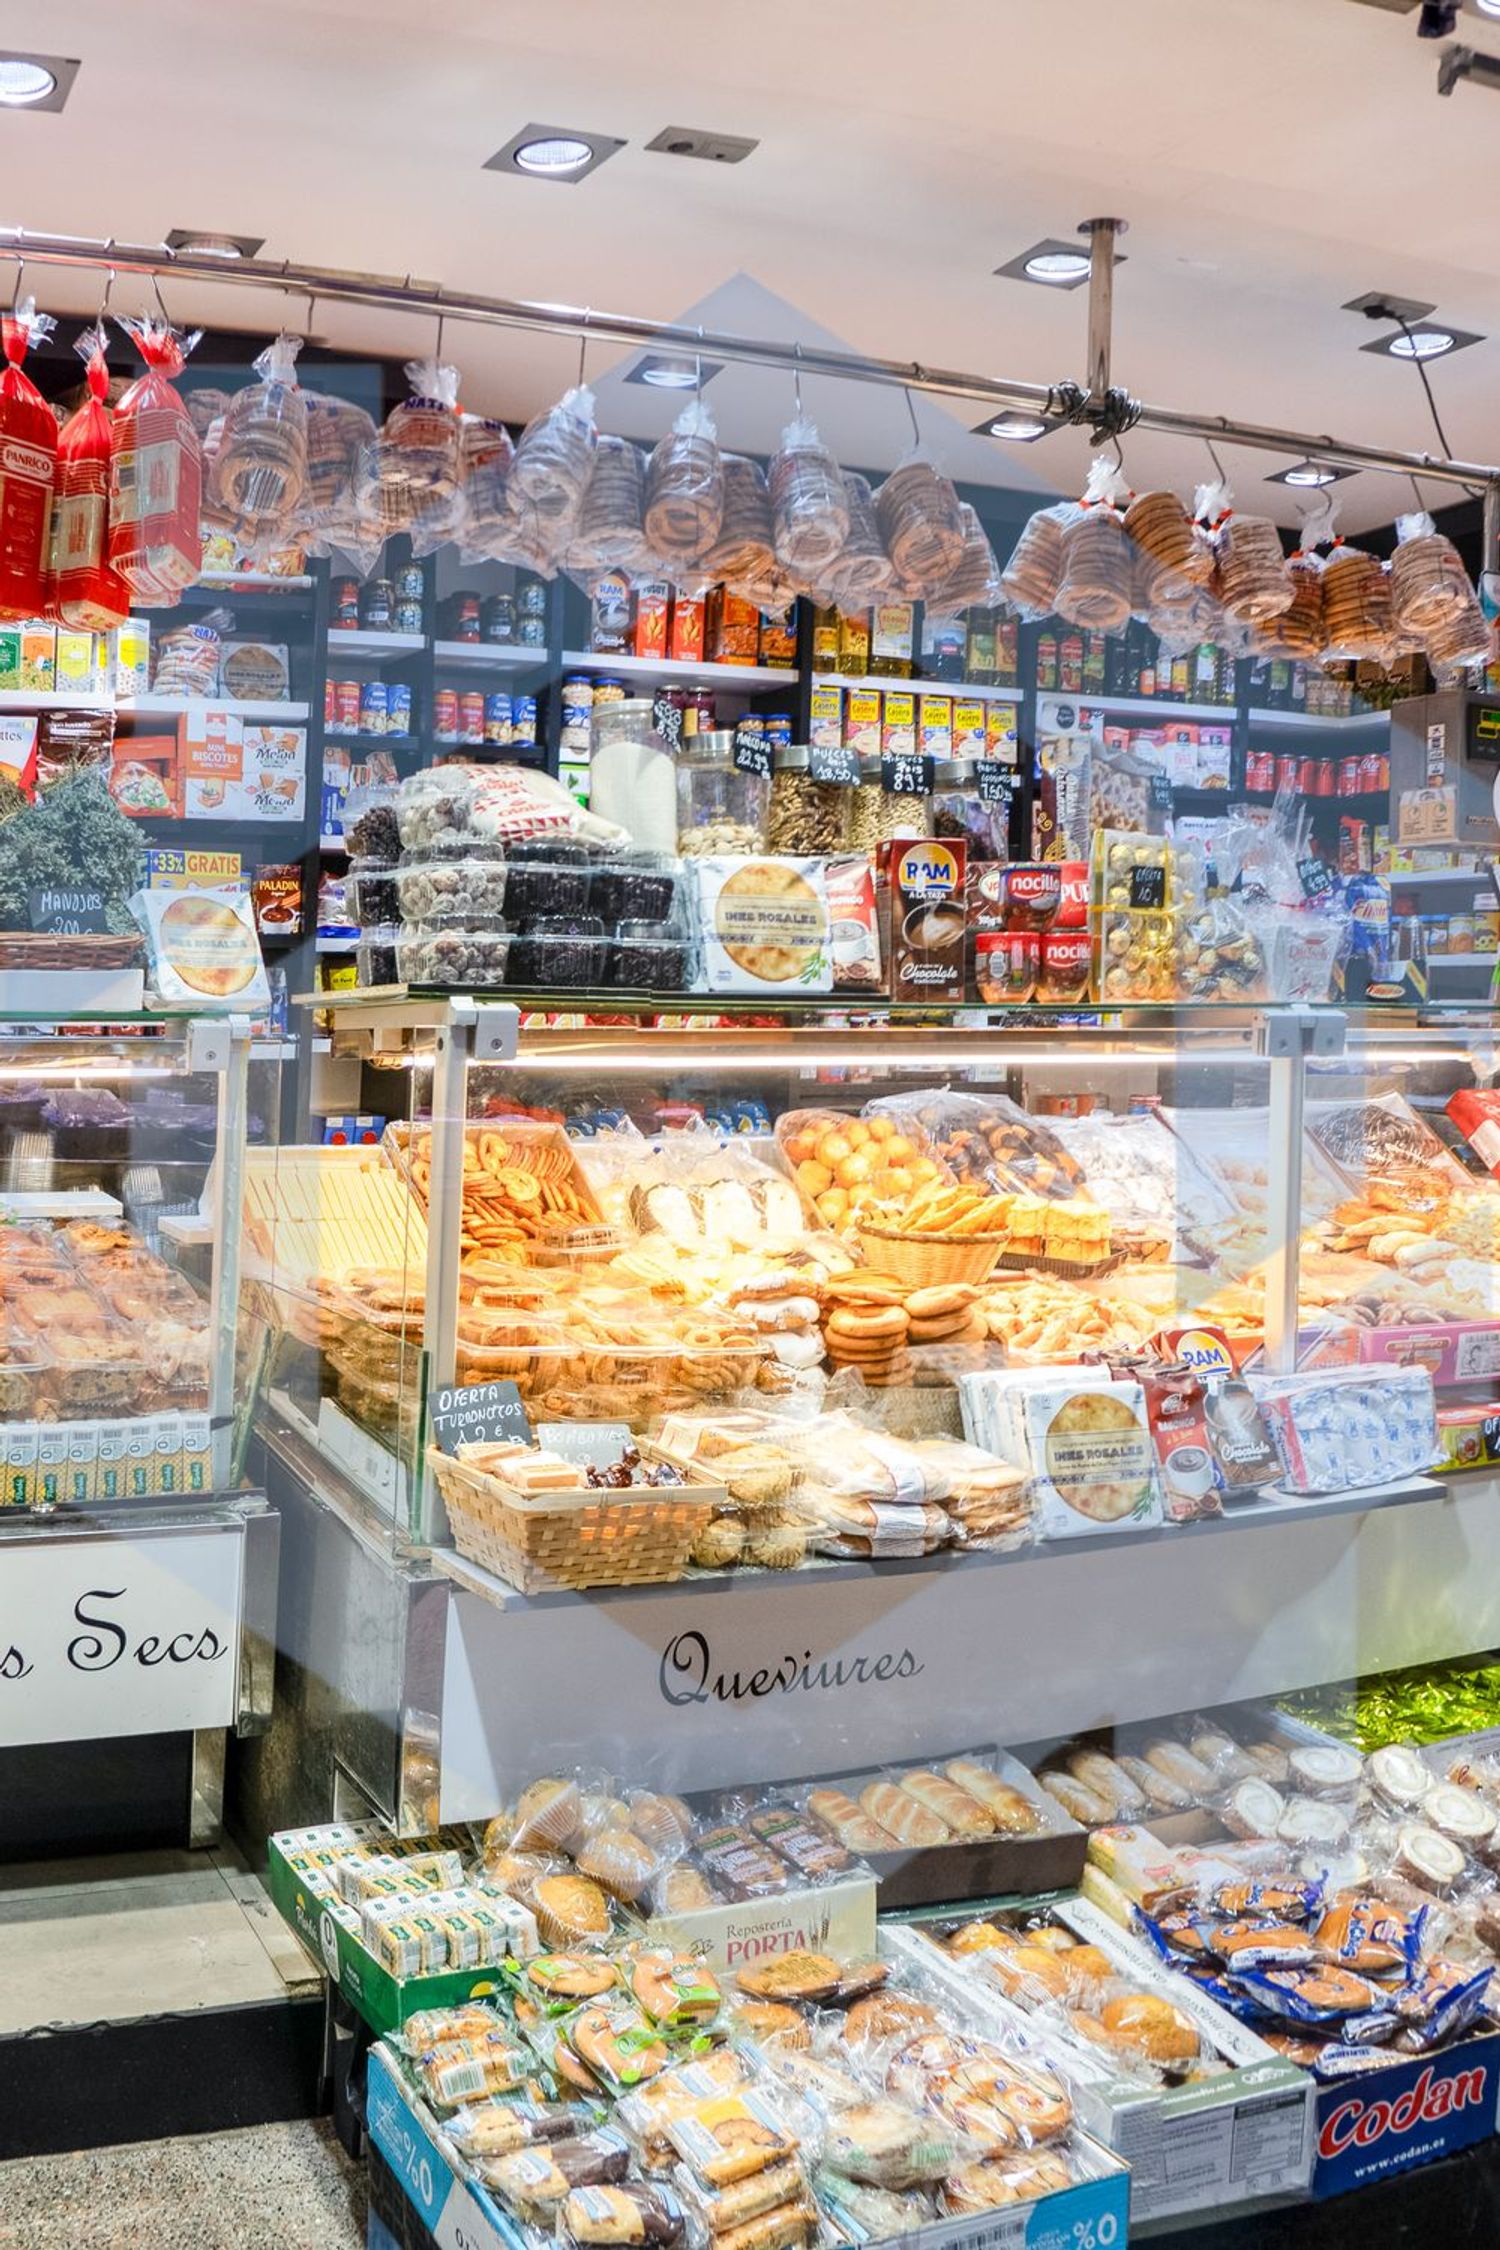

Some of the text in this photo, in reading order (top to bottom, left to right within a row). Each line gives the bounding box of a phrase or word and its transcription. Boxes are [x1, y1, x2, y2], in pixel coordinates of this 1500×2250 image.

[6, 450, 50, 473] PANRICO
[191, 751, 239, 764] BISCOTES
[187, 854, 240, 875] GRATIS
[906, 863, 951, 881] RAM
[259, 880, 299, 892] PALADIN
[41, 891, 103, 913] MANOJOS
[757, 912, 817, 925] ROSALES
[900, 962, 958, 981] Chocolate
[1183, 1347, 1225, 1366] RAM
[439, 1385, 499, 1412] OFERTA
[67, 1587, 229, 1672] Secs
[659, 1630, 926, 1707] Queviures
[726, 1929, 807, 1966] PORTA
[1319, 2065, 1488, 2160] Codan
[1354, 2137, 1446, 2179] www.codan.es
